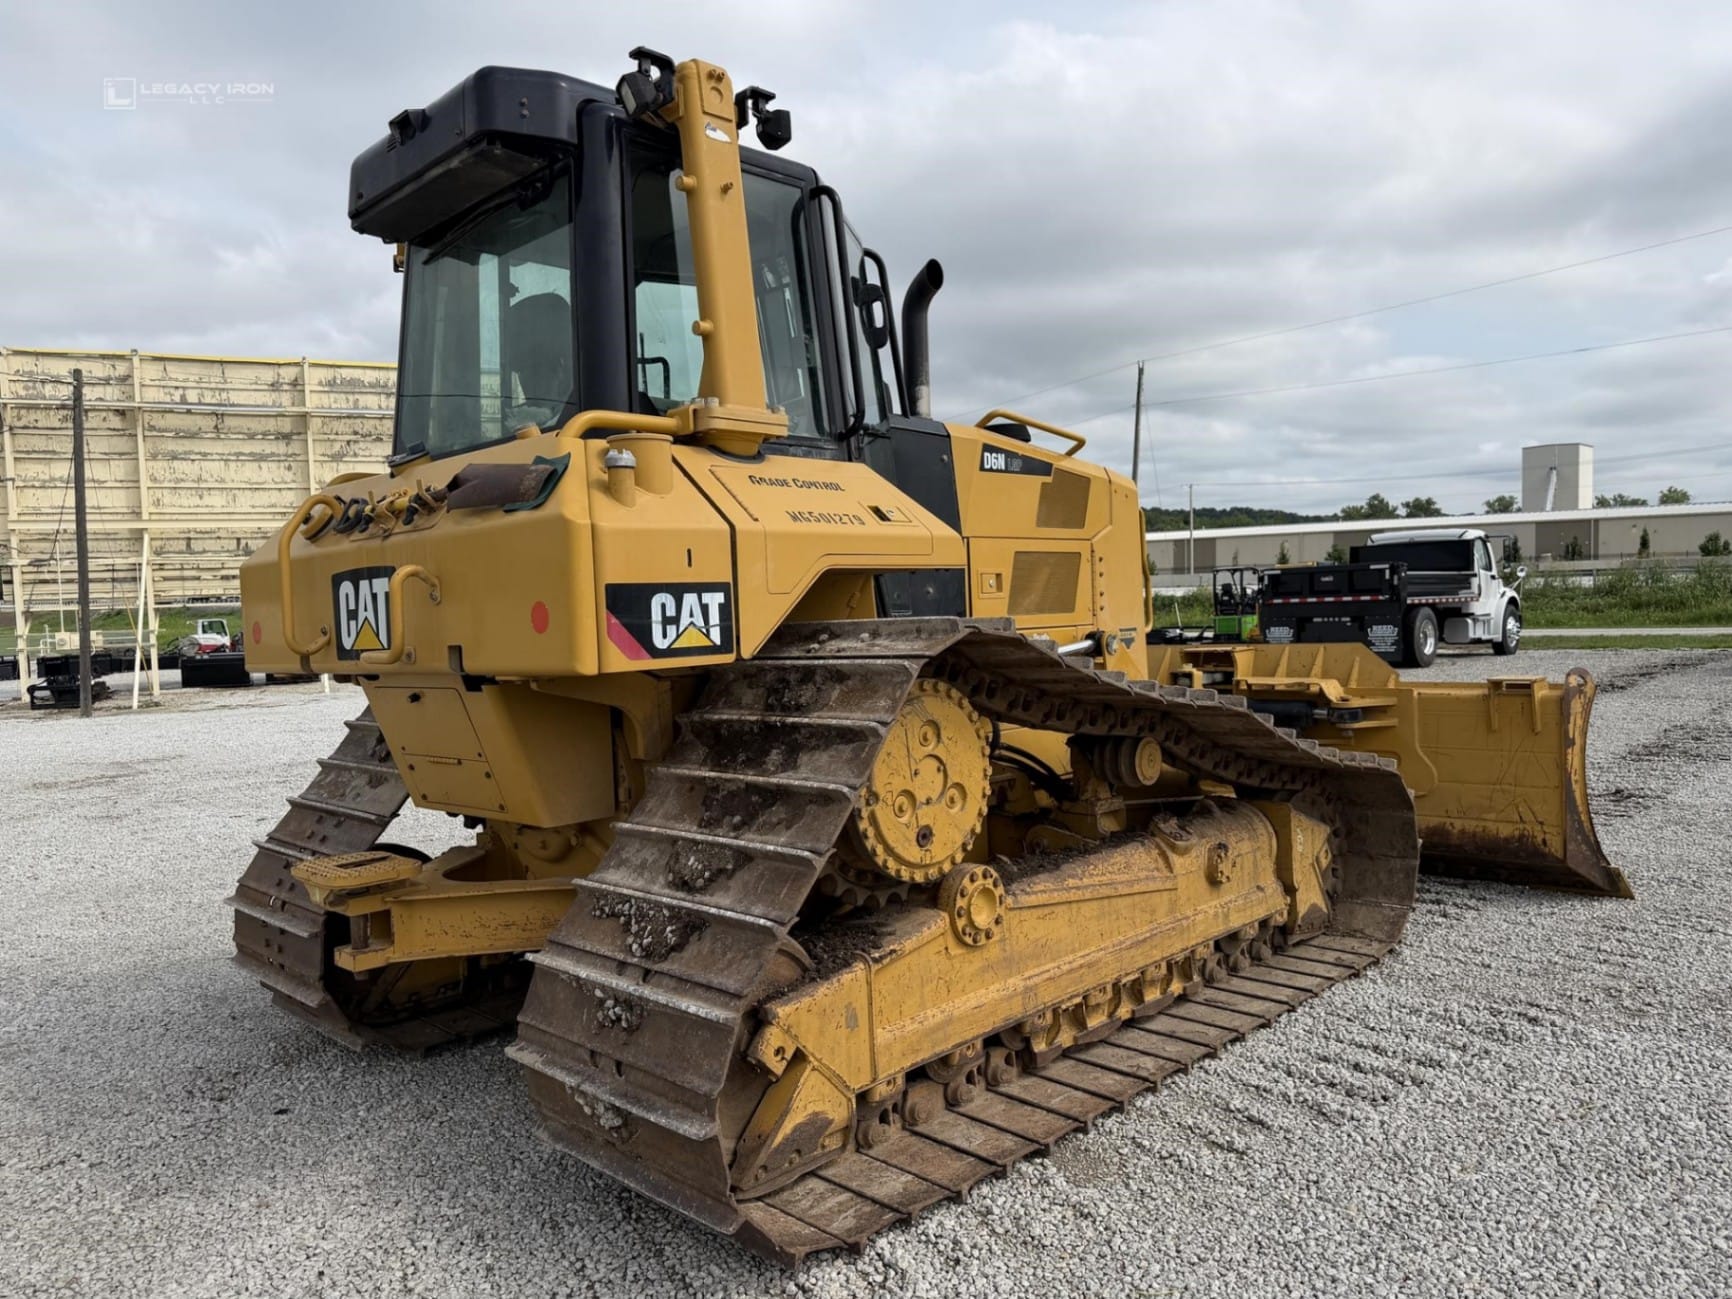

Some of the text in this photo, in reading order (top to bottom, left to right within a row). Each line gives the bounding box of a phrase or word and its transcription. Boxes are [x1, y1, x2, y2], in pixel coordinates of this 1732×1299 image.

[983, 452, 1006, 470] D6N
[339, 577, 390, 650] CAT
[650, 591, 725, 649] CAT
